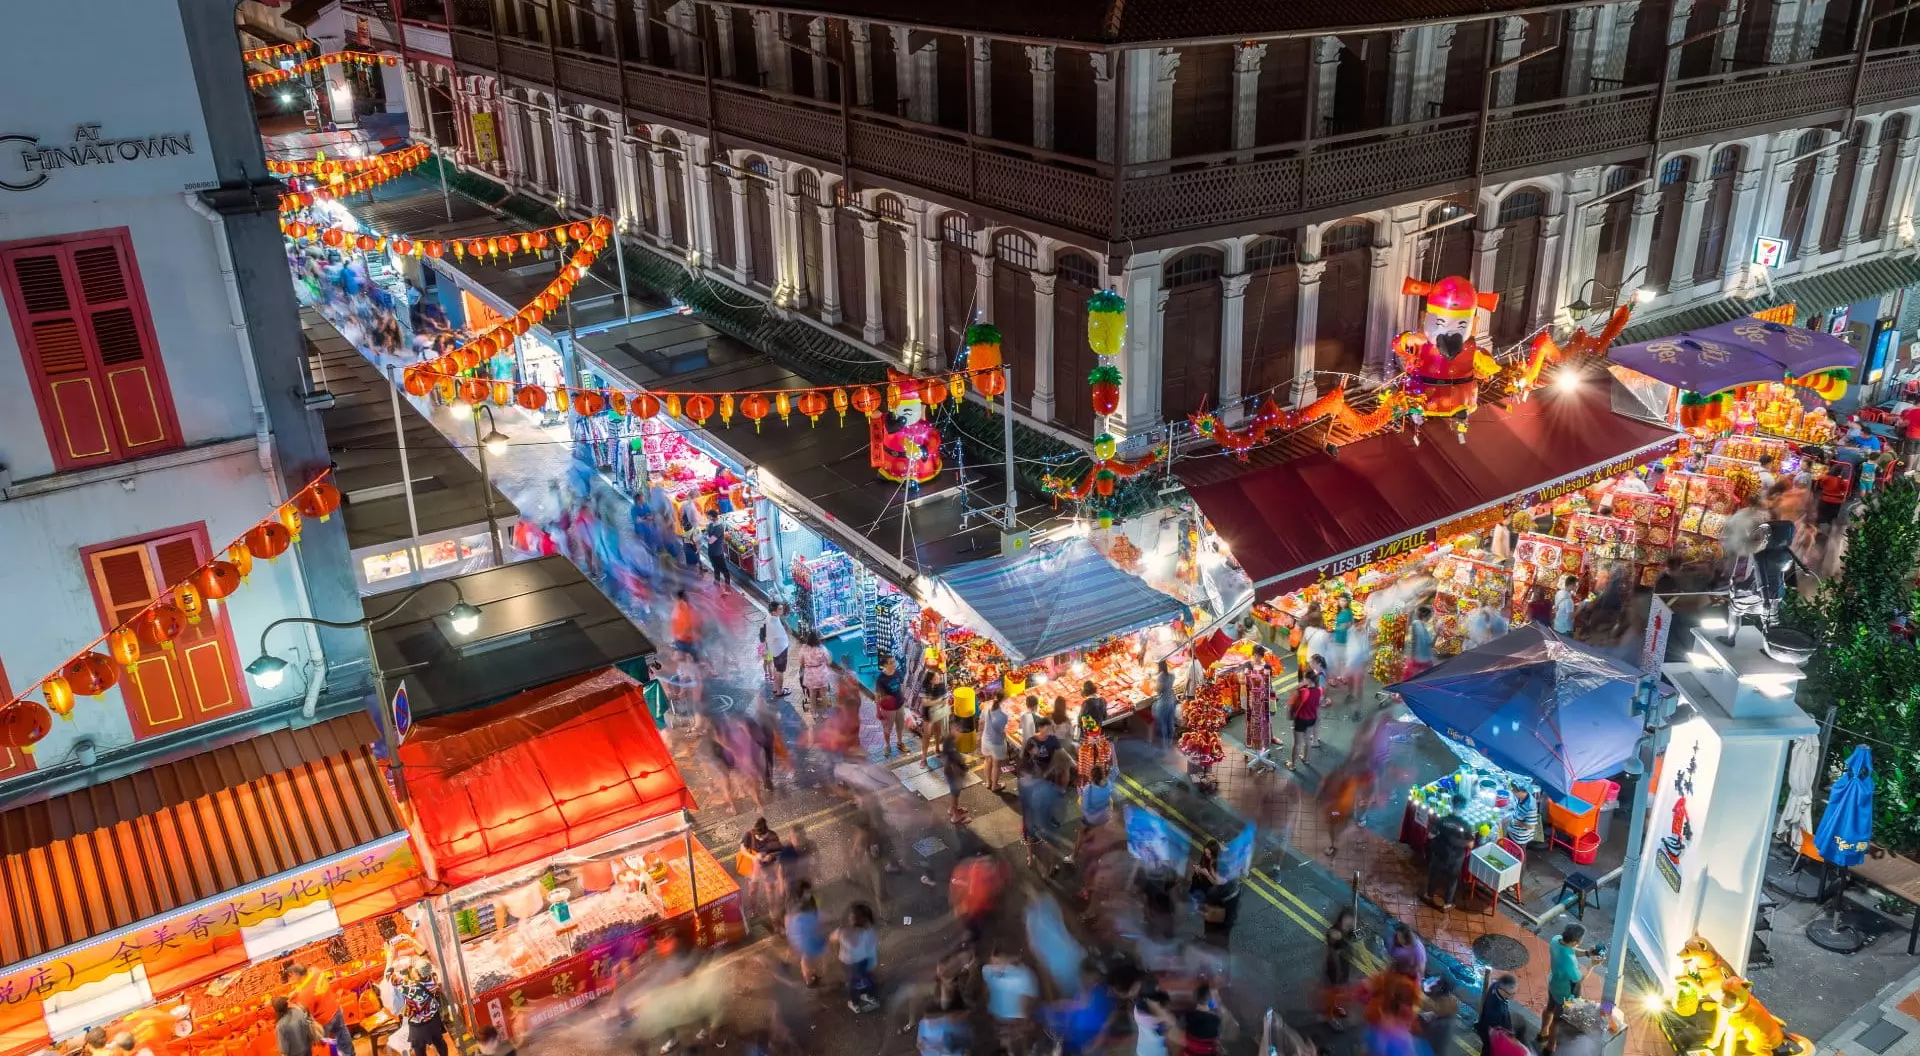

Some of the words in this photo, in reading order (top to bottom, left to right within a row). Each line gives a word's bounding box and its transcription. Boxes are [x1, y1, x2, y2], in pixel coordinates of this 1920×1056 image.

[75, 124, 102, 143] AT
[0, 132, 195, 191] CHINATOWN
[1539, 475, 1592, 501] Wholesale
[1594, 466, 1603, 482] &
[1605, 456, 1635, 478] Retail
[1332, 549, 1374, 576] LESLIE
[1376, 530, 1428, 560] JAVELLE
